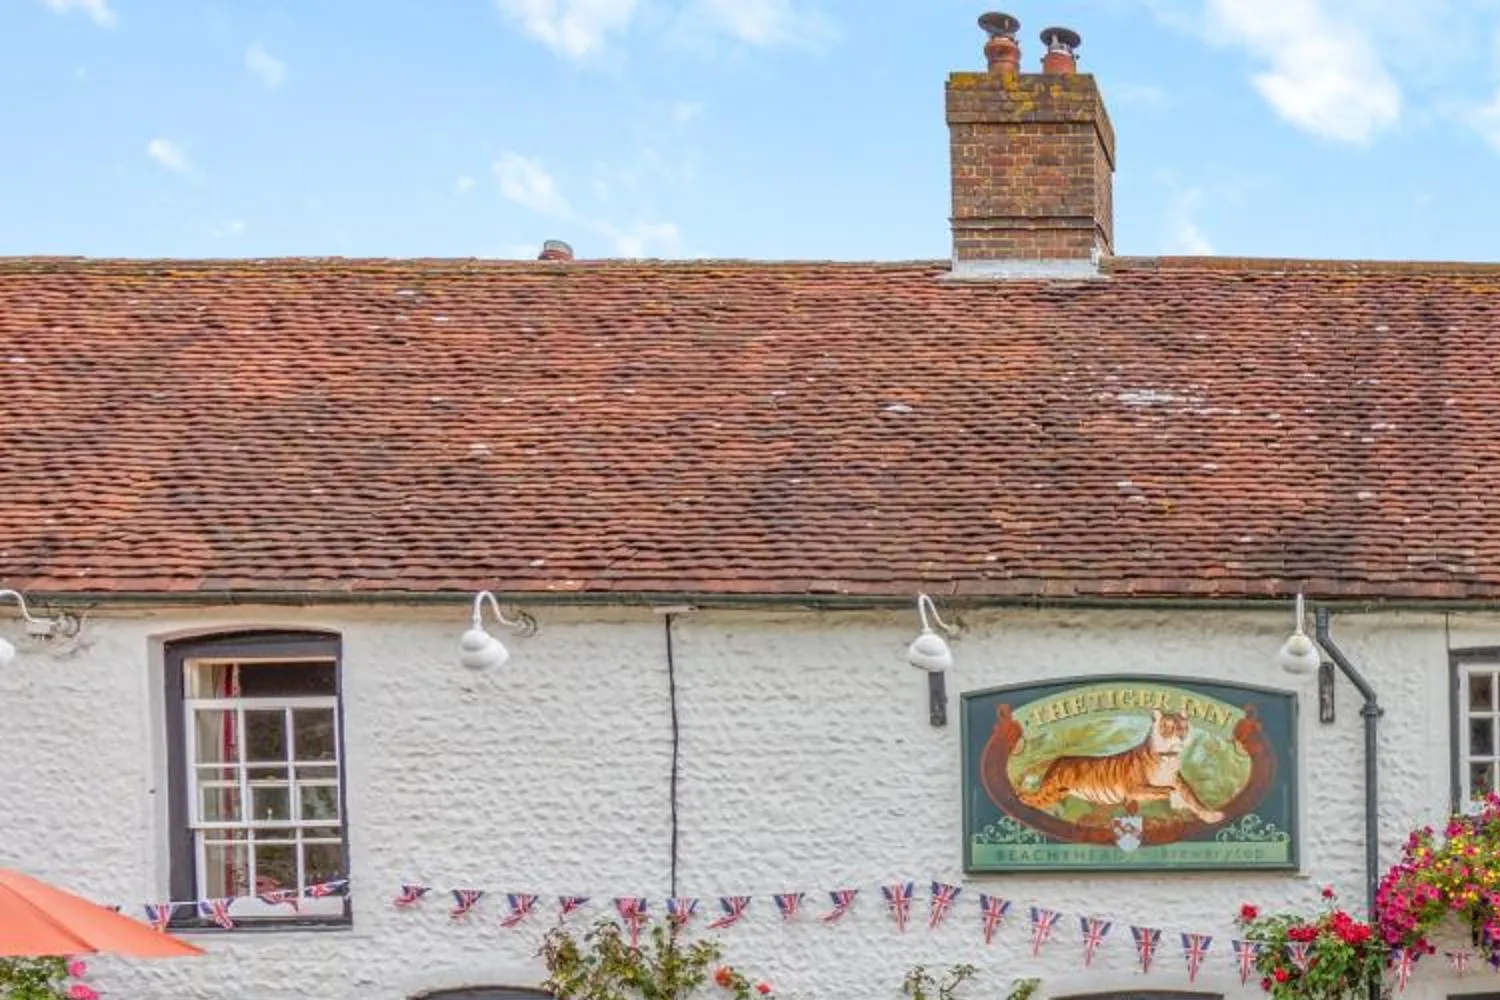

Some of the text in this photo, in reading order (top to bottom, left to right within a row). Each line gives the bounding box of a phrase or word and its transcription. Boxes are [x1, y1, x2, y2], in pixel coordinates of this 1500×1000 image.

[1027, 689, 1233, 727] THE TIGER INN
